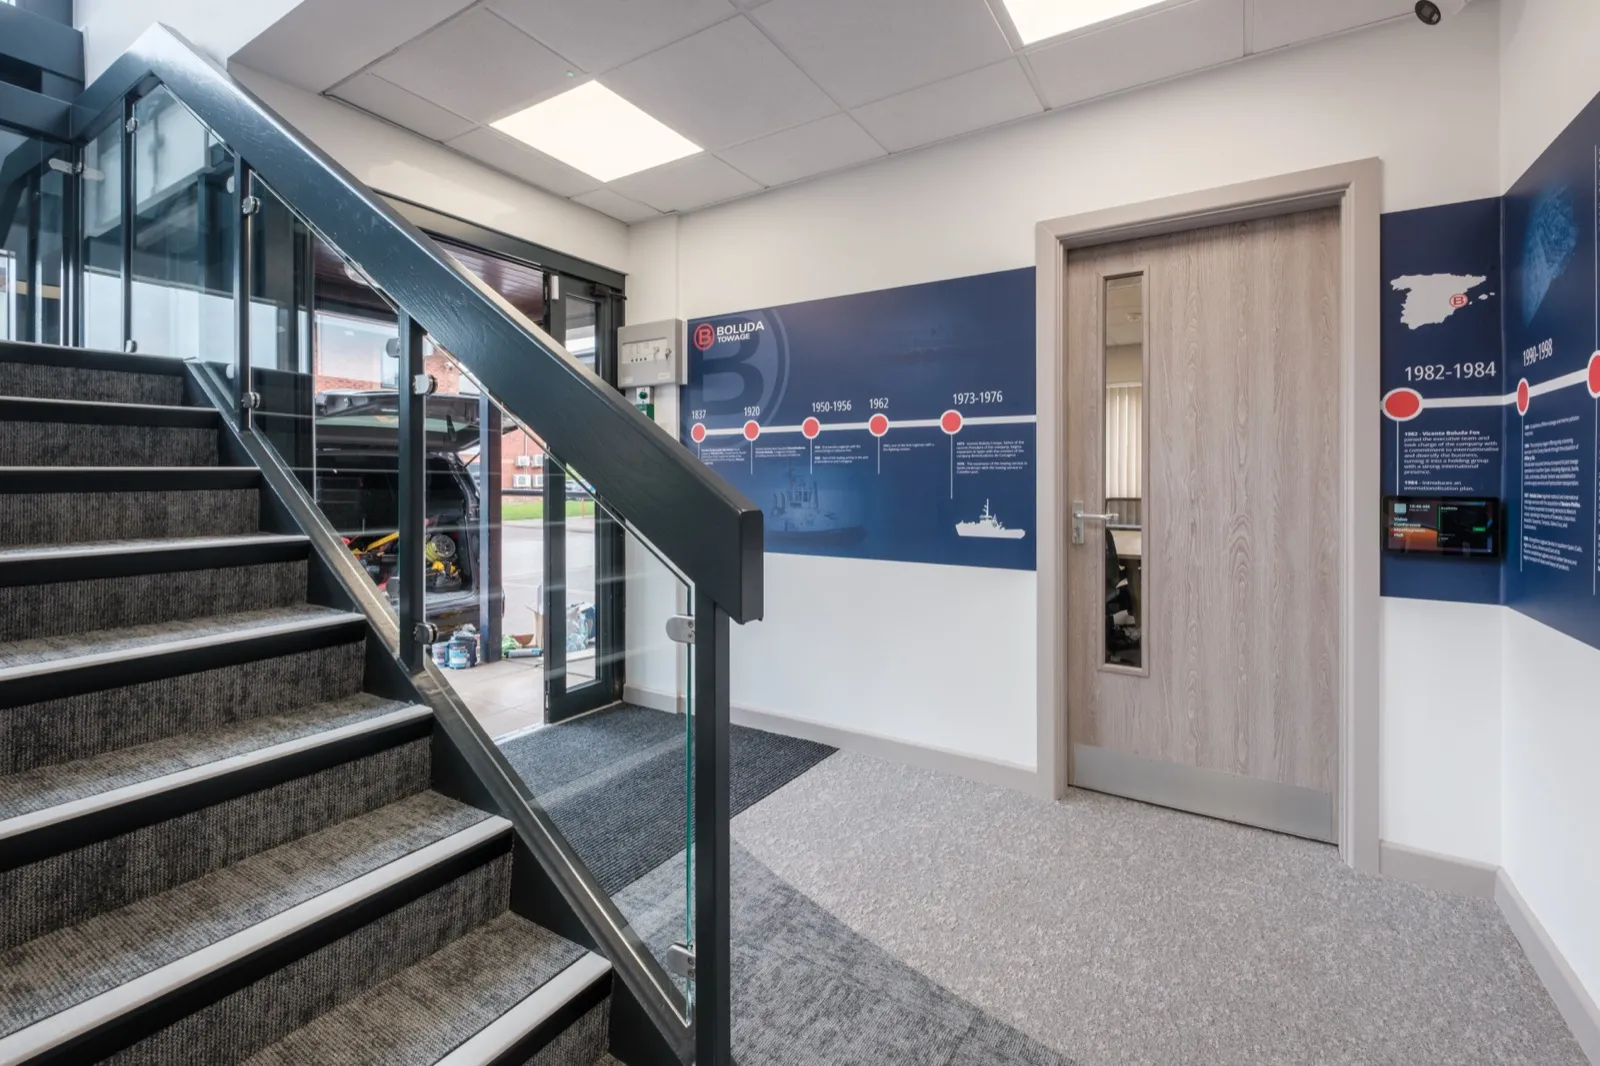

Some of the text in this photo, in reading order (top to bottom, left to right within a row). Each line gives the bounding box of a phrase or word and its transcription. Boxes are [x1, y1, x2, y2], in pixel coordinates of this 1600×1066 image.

[716, 321, 764, 336] BOLUDA
[718, 333, 750, 343] TOWAGE
[1523, 338, 1552, 366] 1990-1998
[1404, 362, 1496, 382] 1982-1984
[869, 398, 889, 409] 1962
[952, 391, 1002, 404] 1973-1976
[744, 406, 760, 416] 1920
[812, 400, 852, 412] 1950-1956
[692, 409, 706, 420] 1837
